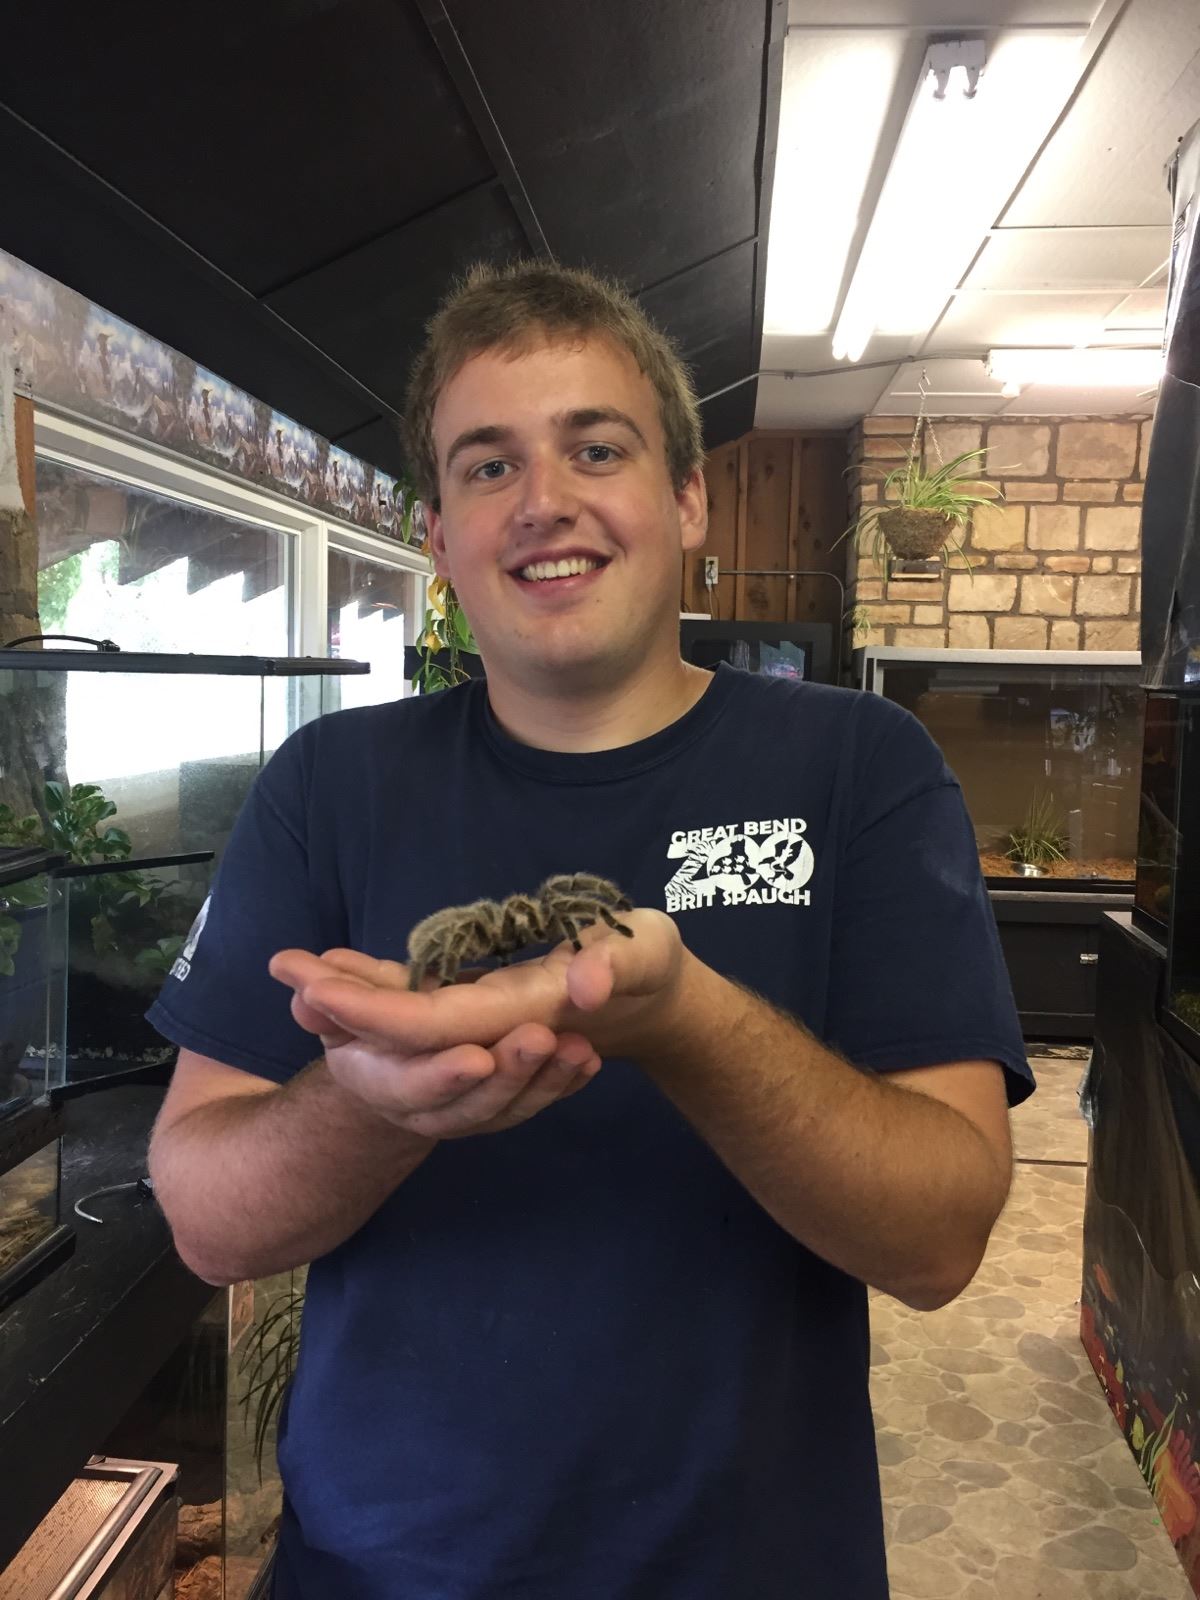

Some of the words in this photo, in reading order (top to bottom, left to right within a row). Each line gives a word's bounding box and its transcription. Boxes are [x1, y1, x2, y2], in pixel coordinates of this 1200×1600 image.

[671, 824, 739, 846] GREAT
[744, 818, 807, 836] BEND
[665, 834, 814, 899] ZOO
[666, 890, 716, 913] BRIT
[722, 888, 811, 906] SPAUGH
